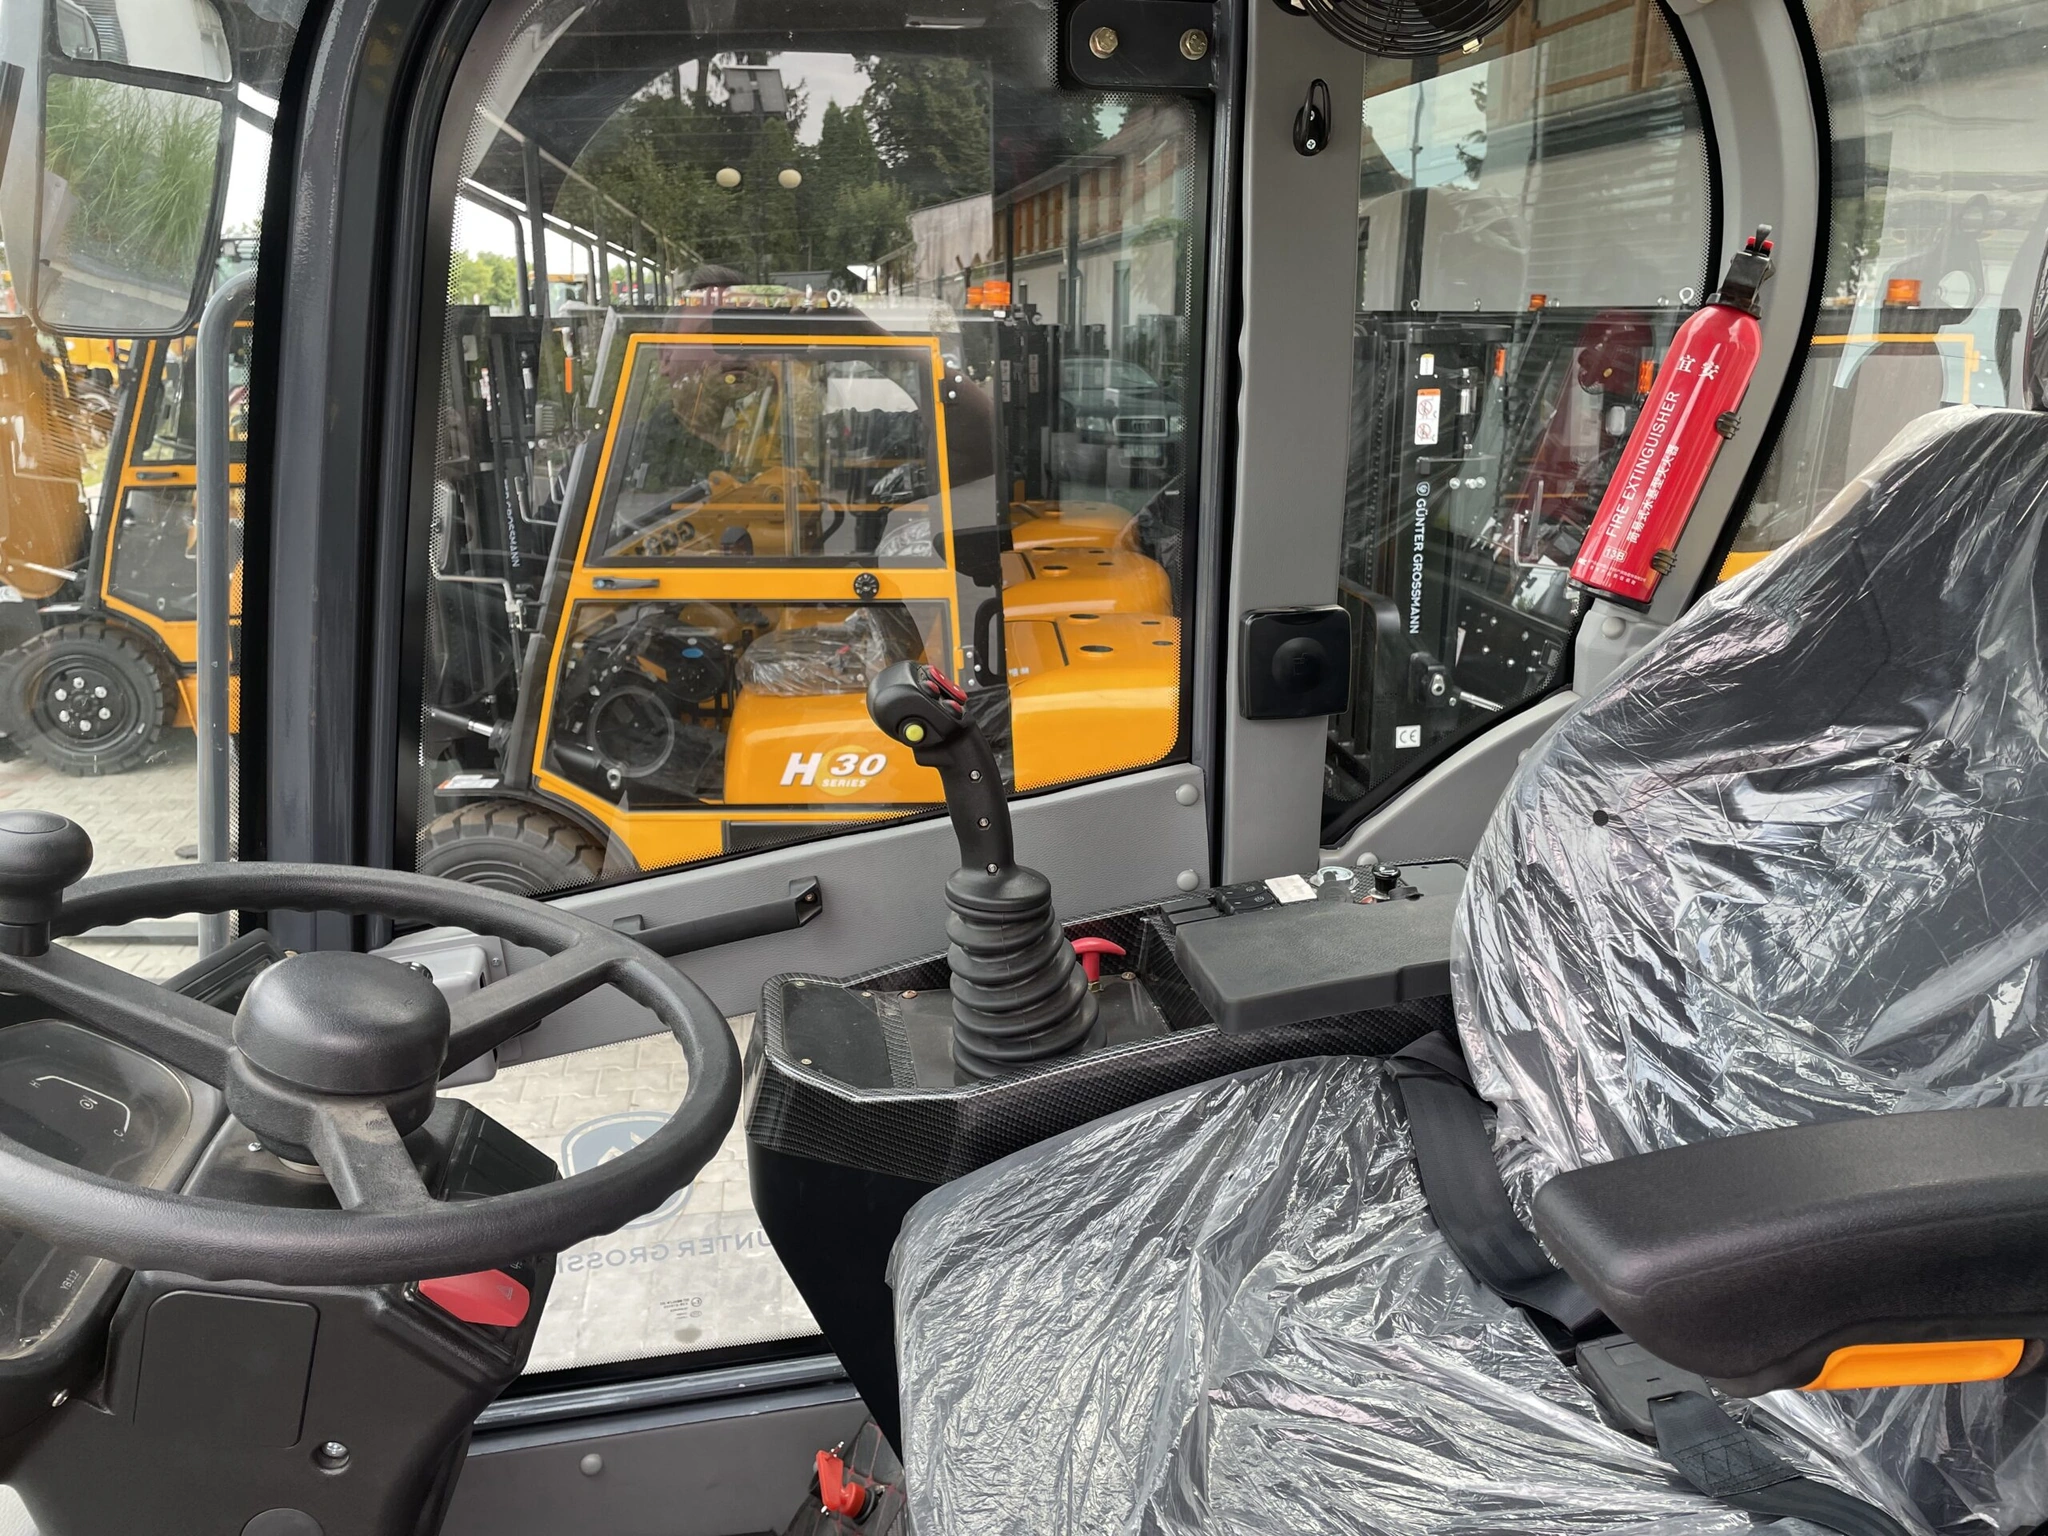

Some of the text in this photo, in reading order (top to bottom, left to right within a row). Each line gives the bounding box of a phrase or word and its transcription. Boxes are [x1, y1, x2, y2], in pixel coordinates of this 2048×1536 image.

[1605, 503, 1629, 538] FIRE
[1621, 391, 1680, 502] EXTINGUISHER
[1409, 498, 1428, 634] GÜNTER GROSSMANN
[780, 752, 888, 786] H 30
[821, 778, 867, 788] SERIES
